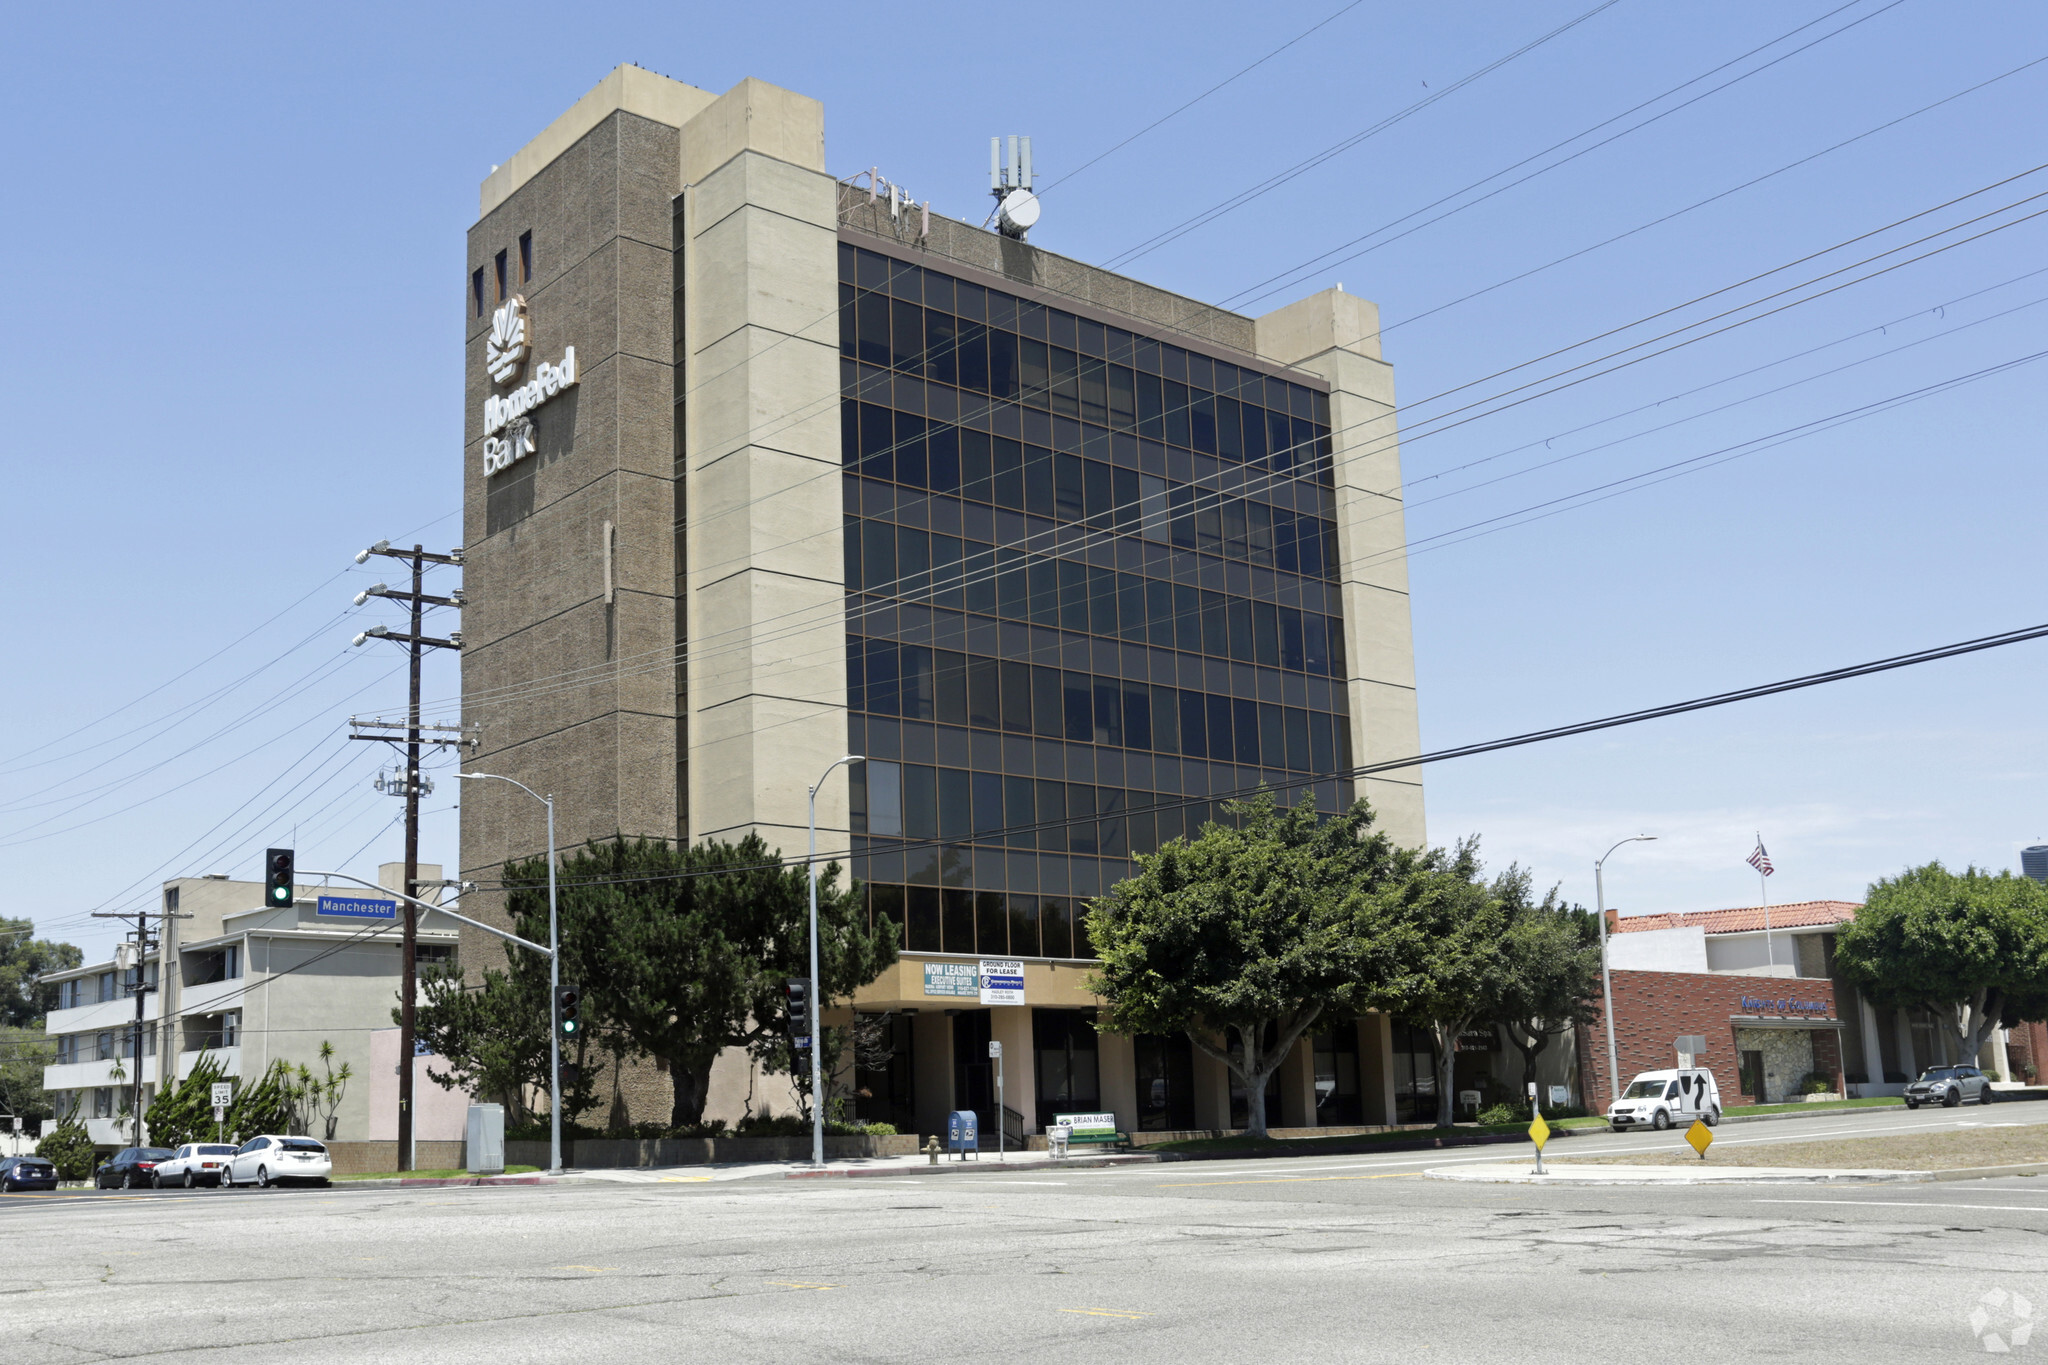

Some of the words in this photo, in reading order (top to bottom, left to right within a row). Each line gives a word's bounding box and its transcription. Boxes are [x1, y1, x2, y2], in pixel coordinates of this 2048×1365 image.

[484, 345, 577, 436] HomeFed
[322, 899, 392, 914] Manchester
[925, 963, 943, 975] NOW
[944, 964, 977, 977] LEASING
[931, 976, 956, 985] EXECUTIVE
[956, 976, 972, 986] SUITES
[214, 1095, 229, 1104] 35
[1073, 1115, 1092, 1125] BRIAN
[1093, 1114, 1114, 1123] MASER
